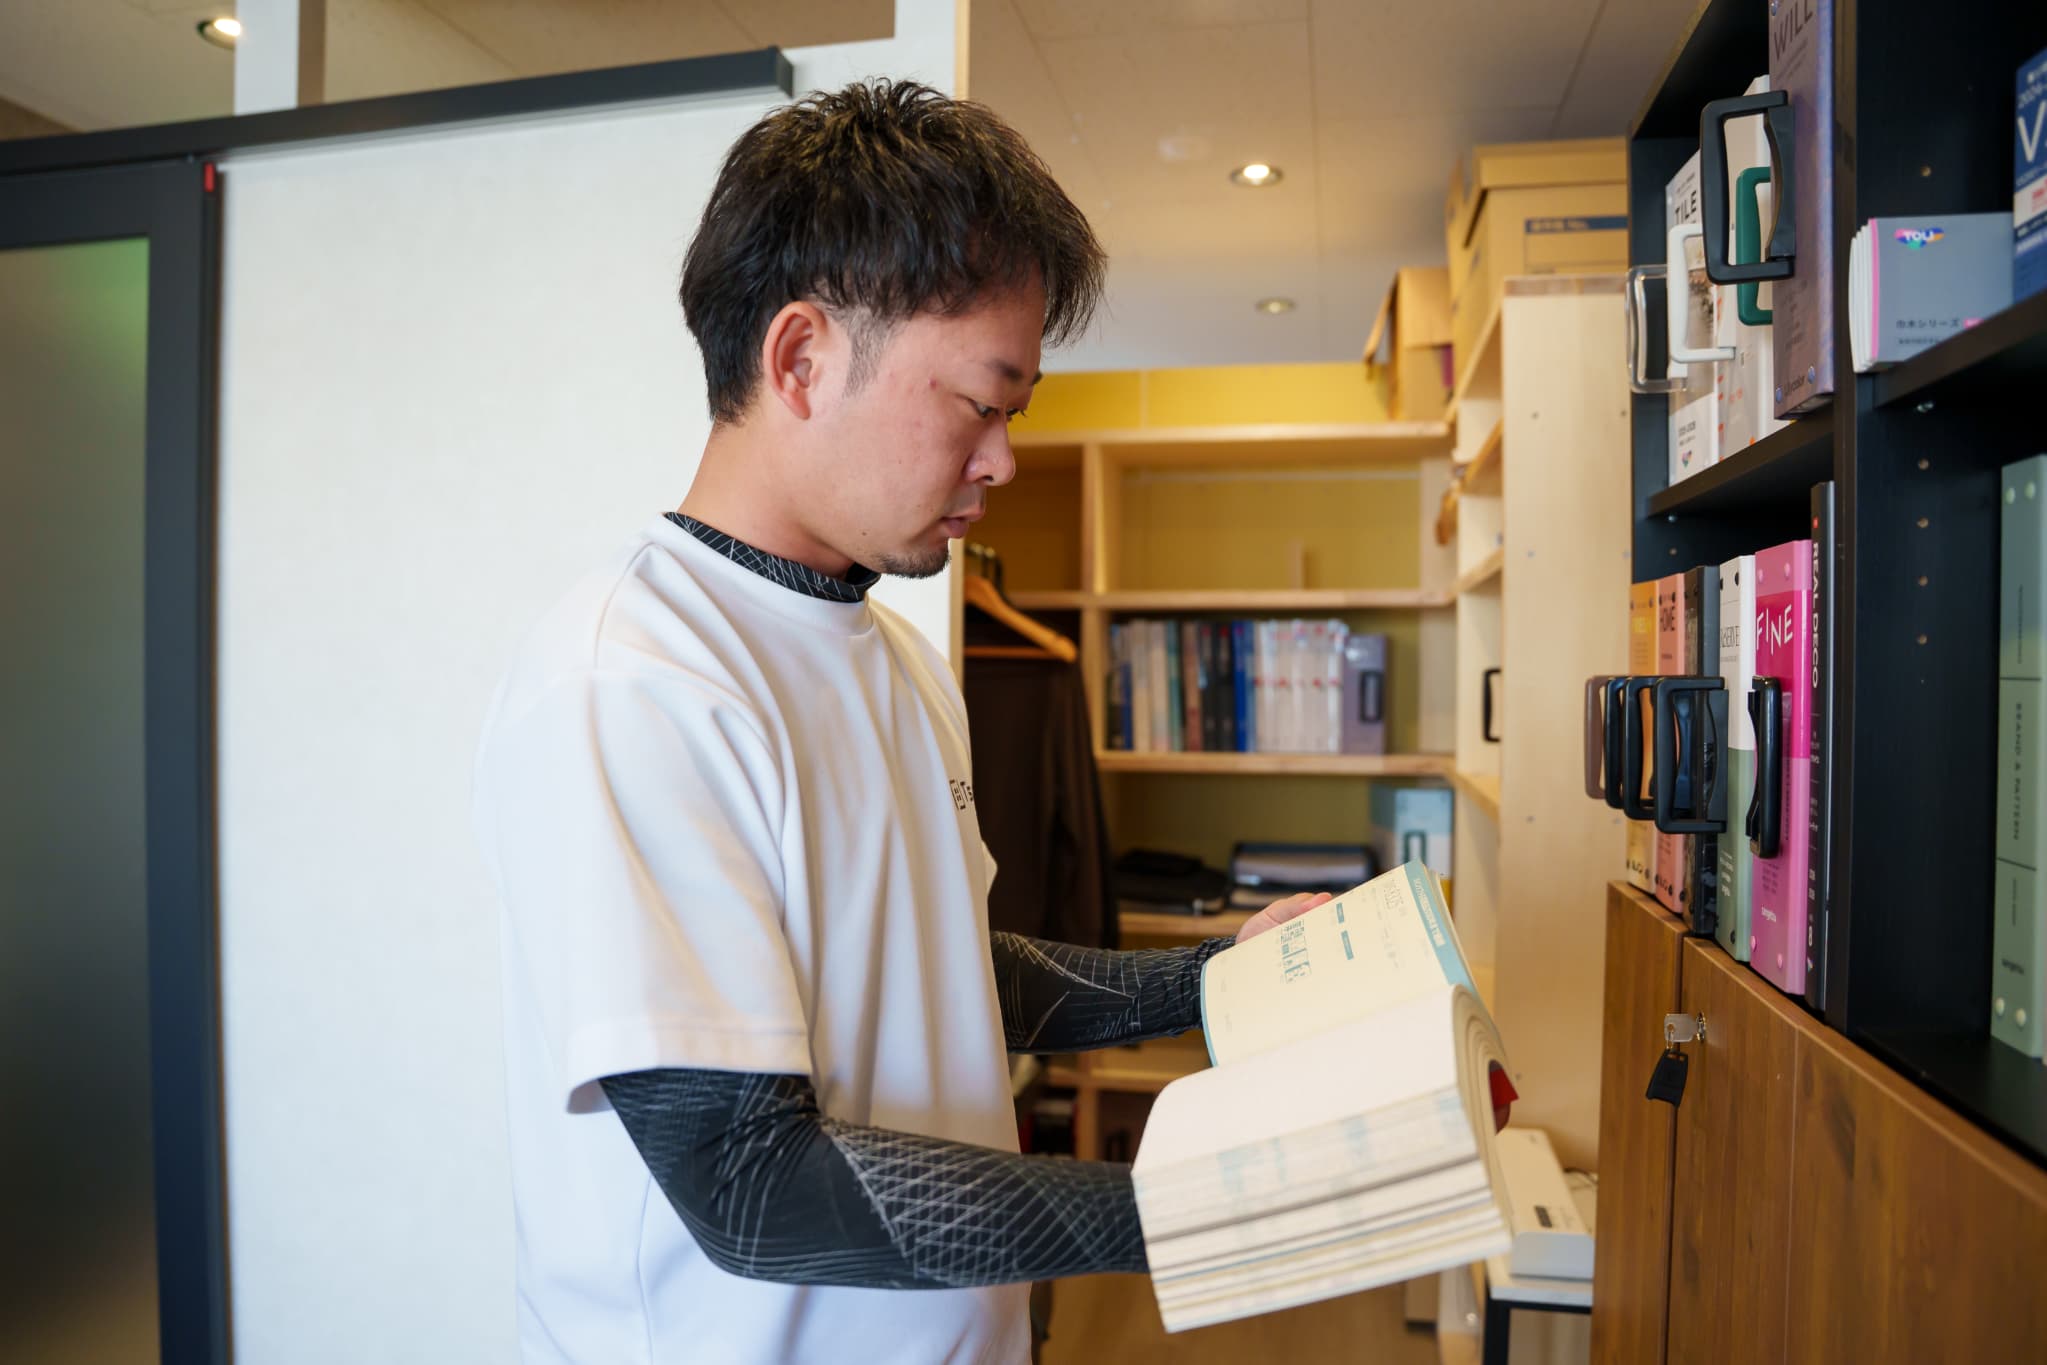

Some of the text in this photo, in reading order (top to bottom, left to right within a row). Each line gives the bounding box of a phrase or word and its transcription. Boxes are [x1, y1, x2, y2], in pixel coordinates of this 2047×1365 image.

[1774, 0, 1813, 61] WILL
[2017, 100, 2047, 162] V
[1675, 190, 1697, 224] TILE
[1903, 230, 1936, 242] TOLI
[1756, 603, 1793, 656] FINE
